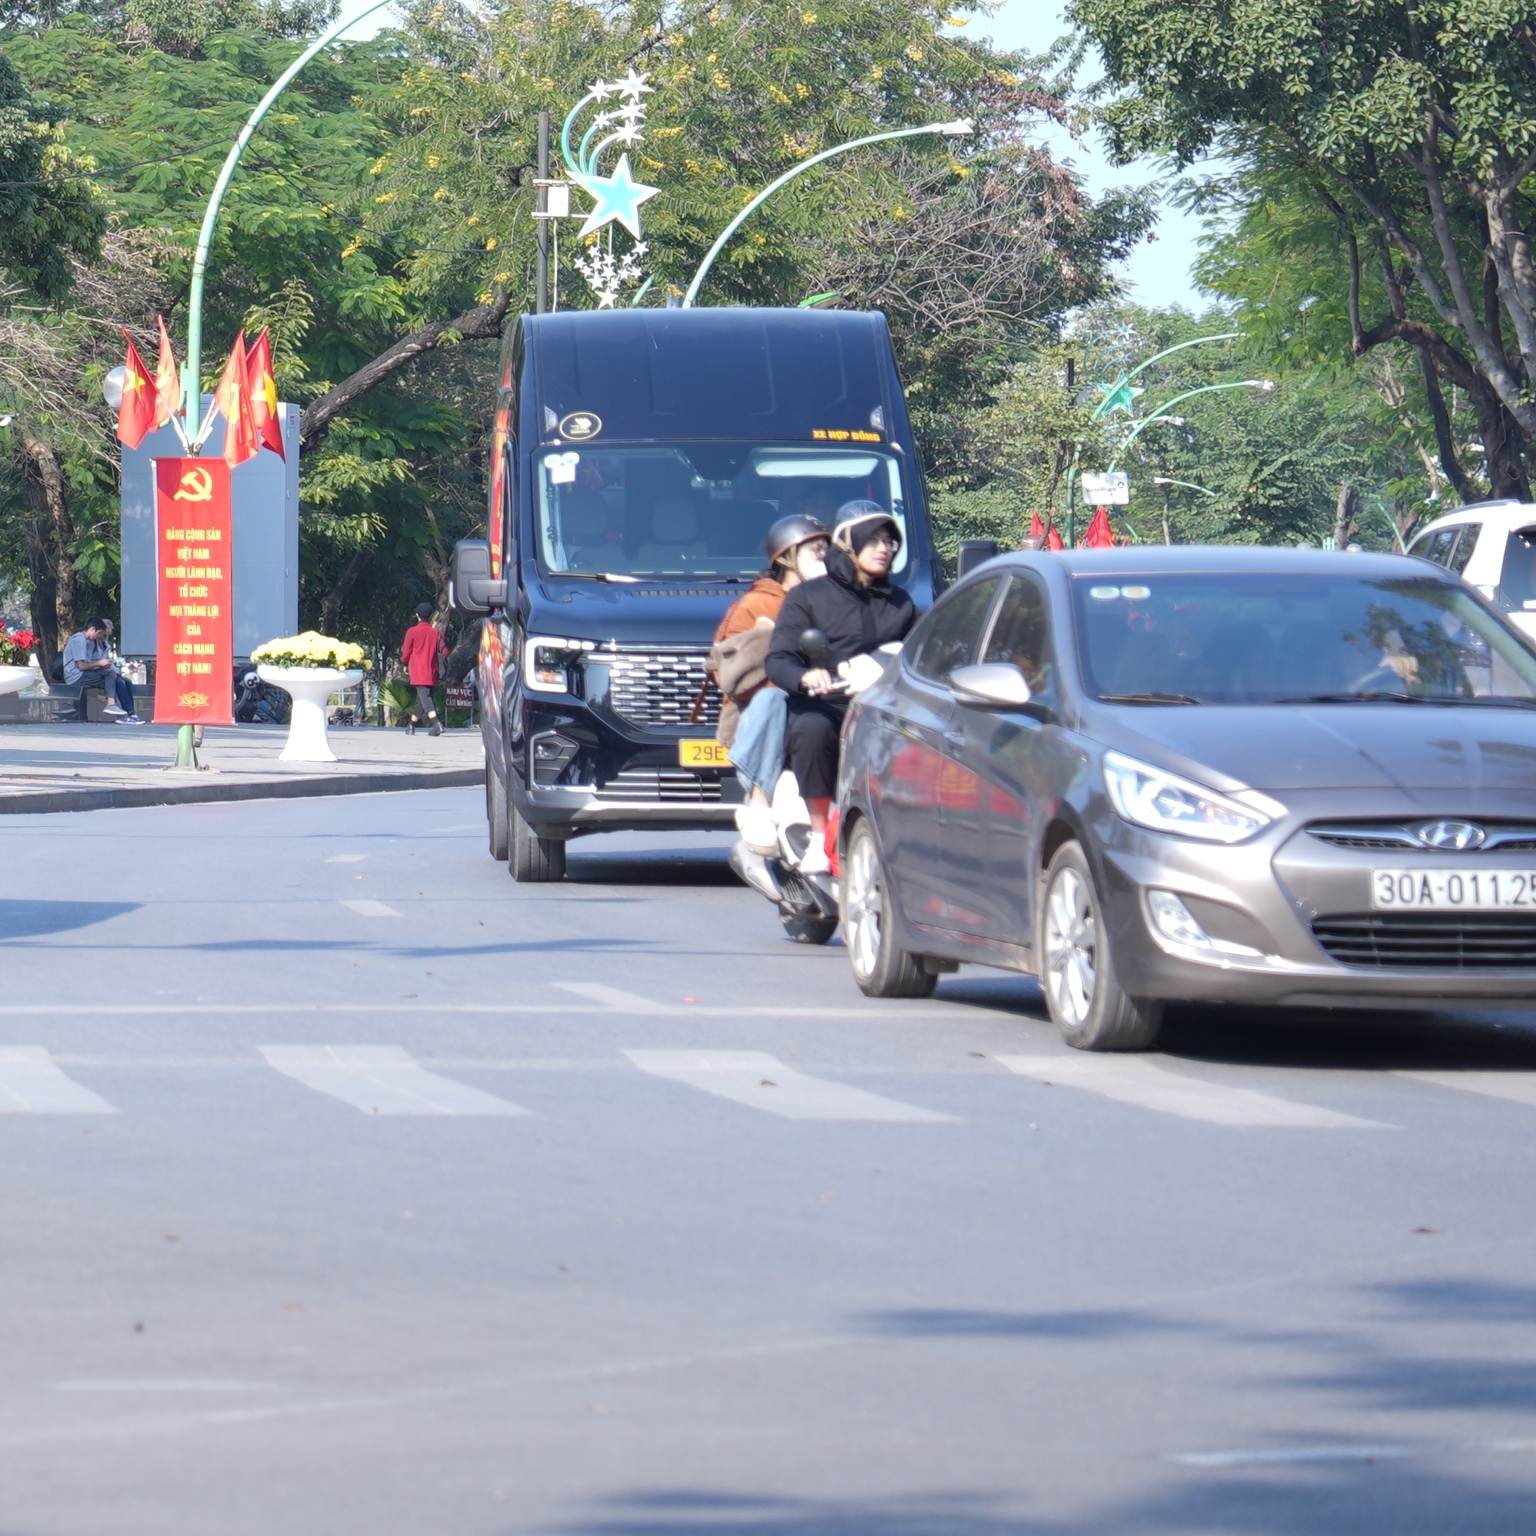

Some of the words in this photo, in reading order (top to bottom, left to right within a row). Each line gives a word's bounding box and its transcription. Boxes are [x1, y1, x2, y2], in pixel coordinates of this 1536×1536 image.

[812, 429, 827, 439] XE
[828, 430, 849, 440] HỢP
[851, 429, 881, 442] ĐỒNG
[166, 526, 184, 540] ĐẢNG
[186, 527, 205, 542] CỘNG
[206, 526, 221, 541] SẢN
[177, 546, 192, 561] VIỆT
[193, 548, 209, 559] NAM
[166, 565, 186, 578] NGƯỜI
[189, 584, 208, 597] CHỨC
[170, 605, 182, 618] MỌI
[207, 605, 219, 619] LỢI
[187, 622, 201, 636] CỦA
[174, 642, 192, 654] CÁCH
[193, 643, 214, 657] MẠNG
[176, 661, 191, 676] VIỆT
[192, 662, 212, 674] NAM!
